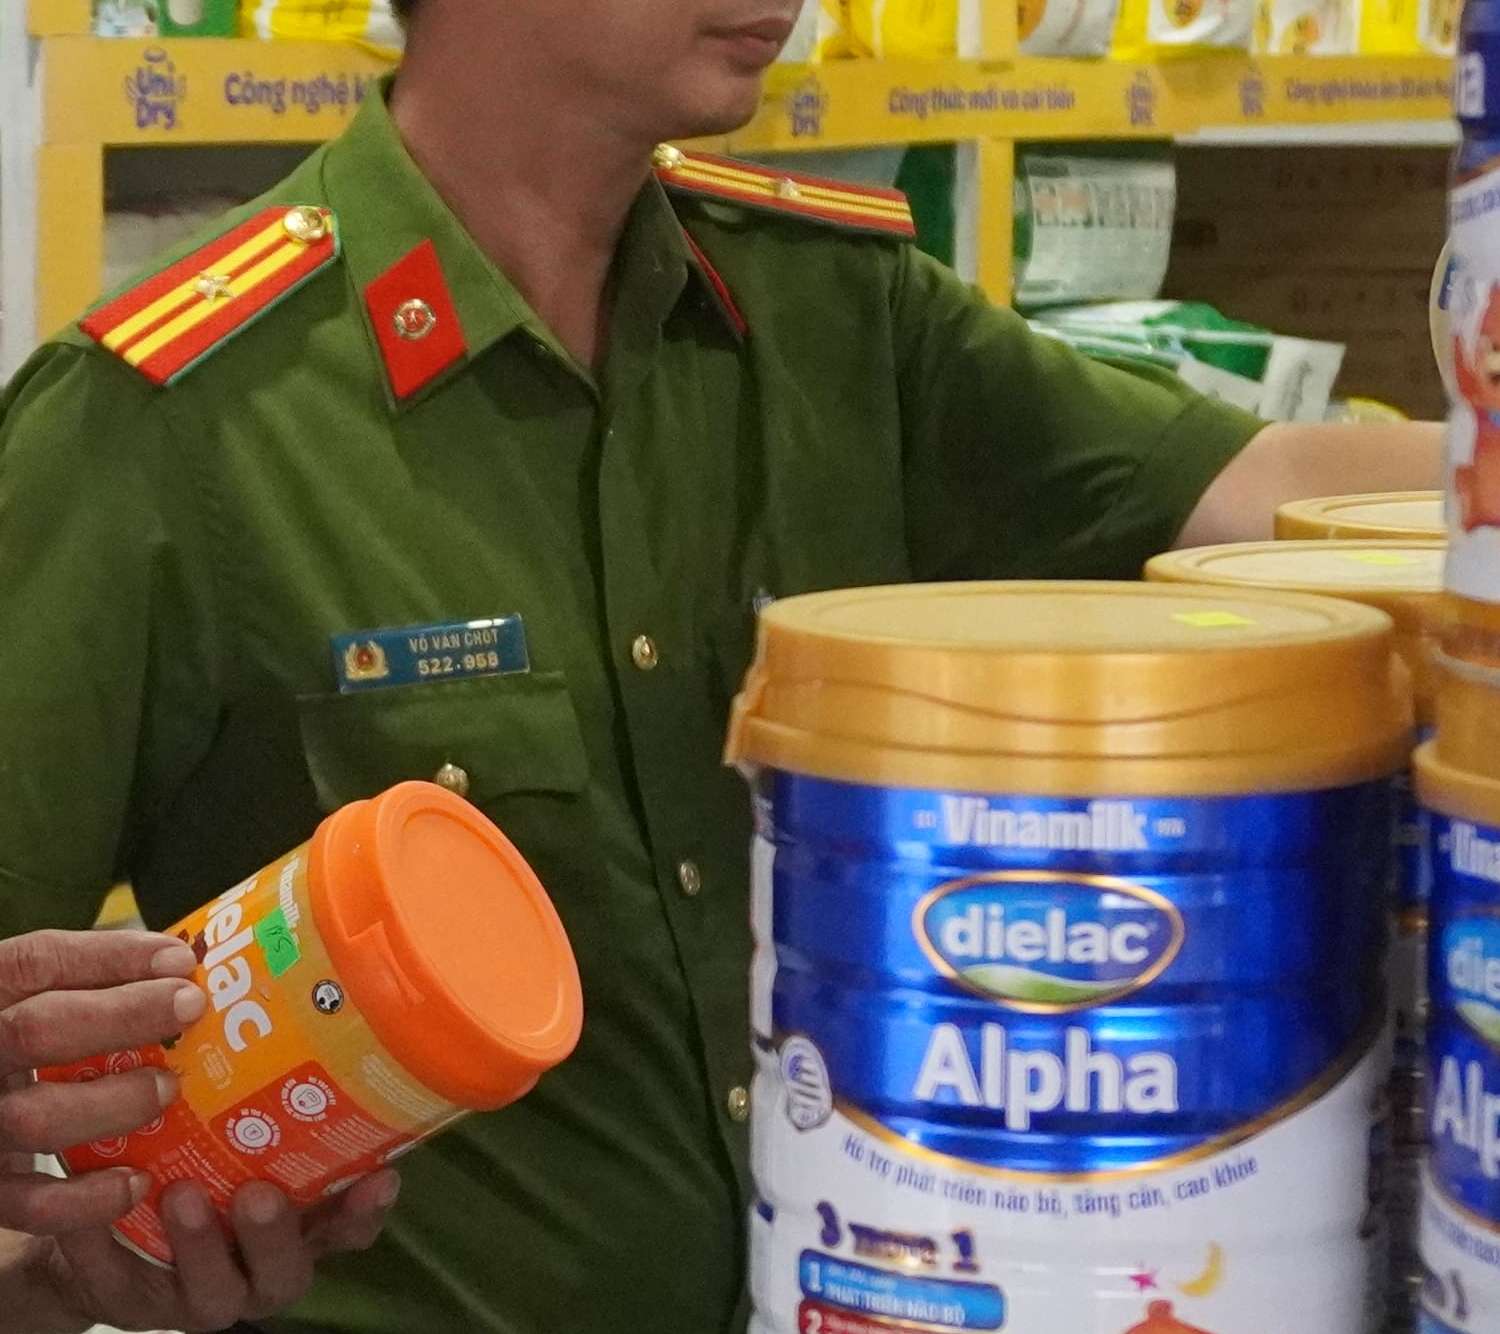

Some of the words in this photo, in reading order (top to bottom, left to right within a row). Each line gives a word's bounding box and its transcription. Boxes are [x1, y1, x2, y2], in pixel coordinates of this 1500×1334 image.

[417, 650, 499, 676] 522.958
[940, 795, 1149, 851] Vinamilk
[940, 902, 1151, 966] dielac
[913, 1021, 1181, 1133] Alpha
[1175, 1175, 1210, 1202] cao
[950, 1227, 979, 1274] 1
